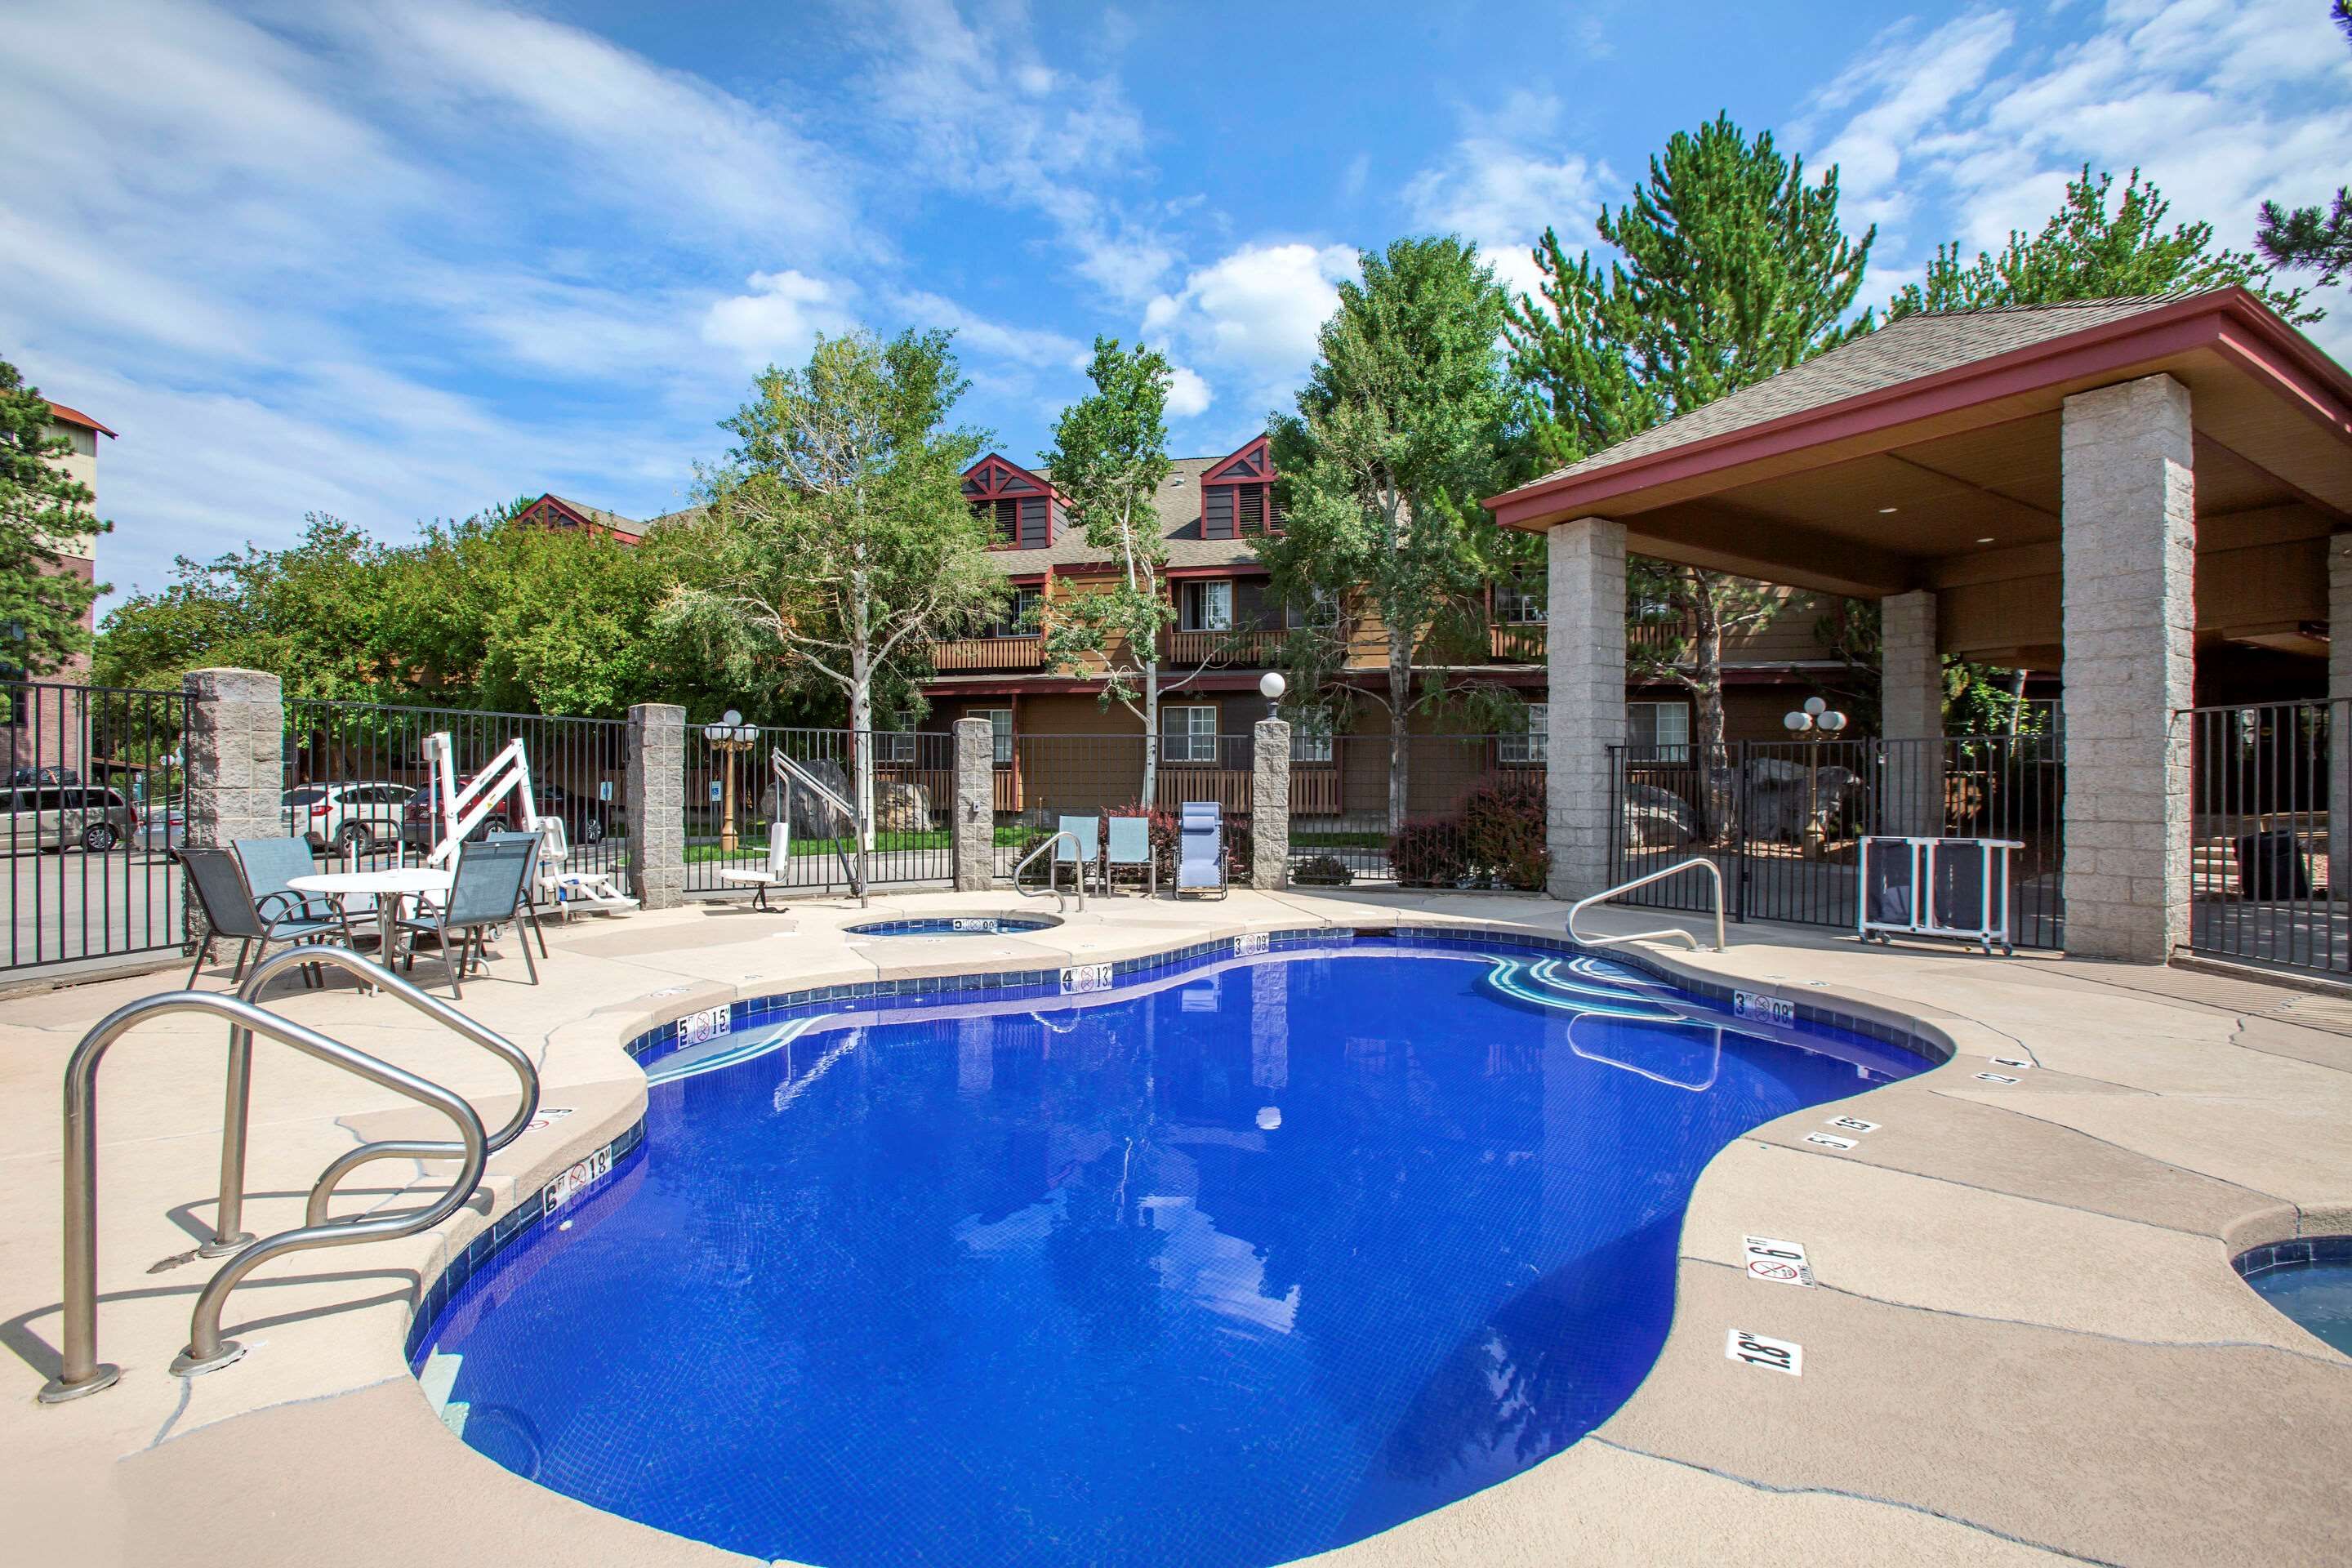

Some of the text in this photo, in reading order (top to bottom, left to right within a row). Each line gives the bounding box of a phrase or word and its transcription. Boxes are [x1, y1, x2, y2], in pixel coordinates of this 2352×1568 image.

[1062, 969, 1073, 982] 4
[1736, 993, 1744, 1014] 3
[546, 1185, 557, 1213] 6
[1748, 1246, 1802, 1259] 6
